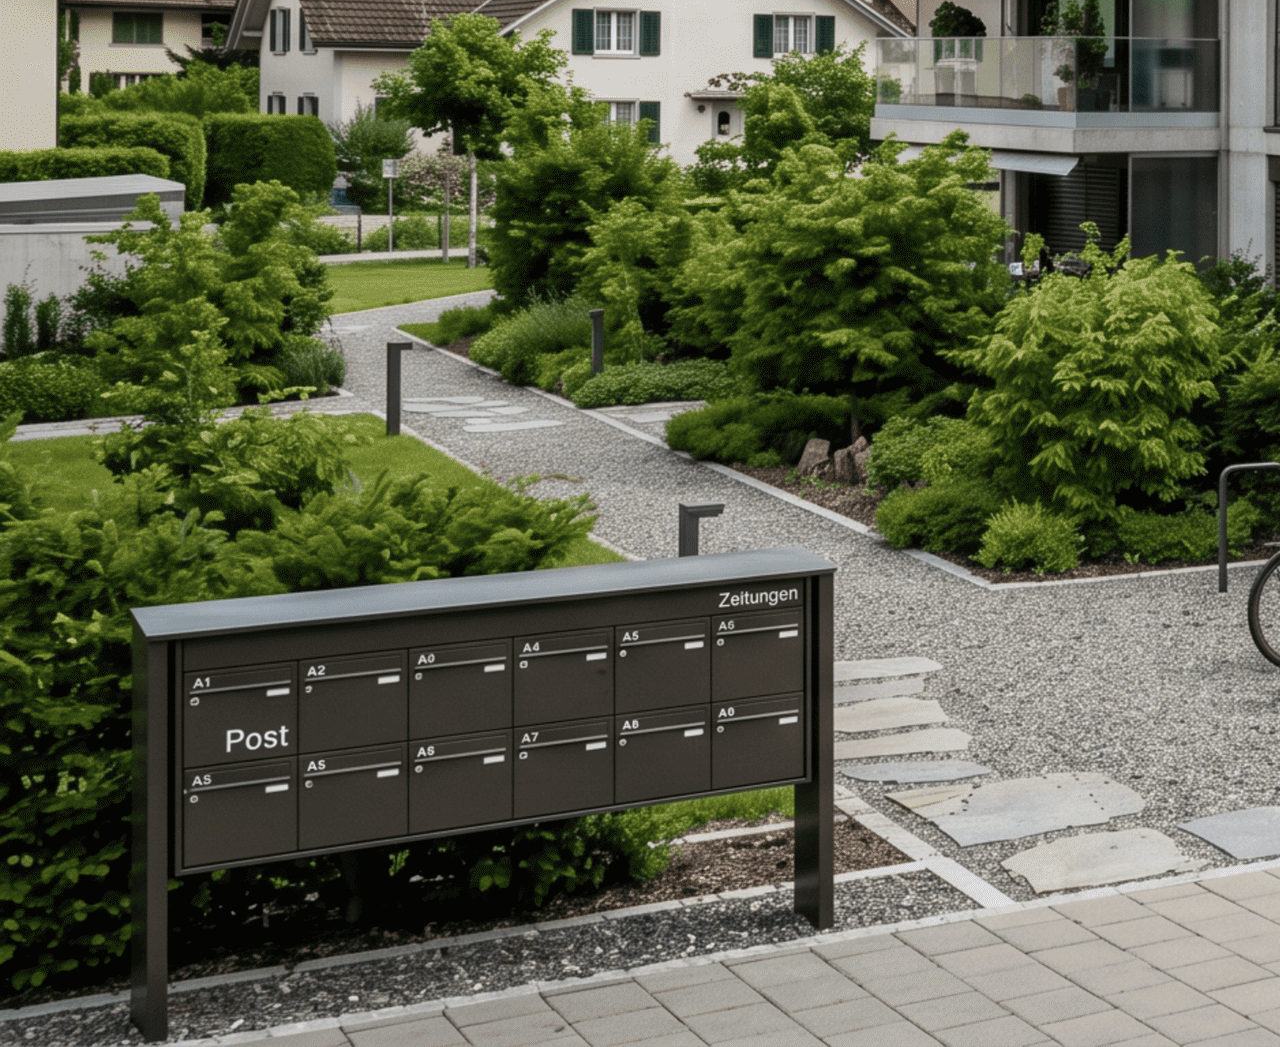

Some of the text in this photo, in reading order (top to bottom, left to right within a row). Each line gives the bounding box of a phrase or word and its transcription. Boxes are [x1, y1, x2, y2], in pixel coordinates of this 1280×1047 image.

[718, 588, 799, 608] Zeitungen
[718, 620, 735, 632] A6
[622, 630, 640, 642] A5
[522, 642, 540, 653] A4
[306, 665, 326, 677] A2
[192, 677, 211, 689] A1
[226, 725, 289, 753] Post
[521, 732, 540, 744] A7
